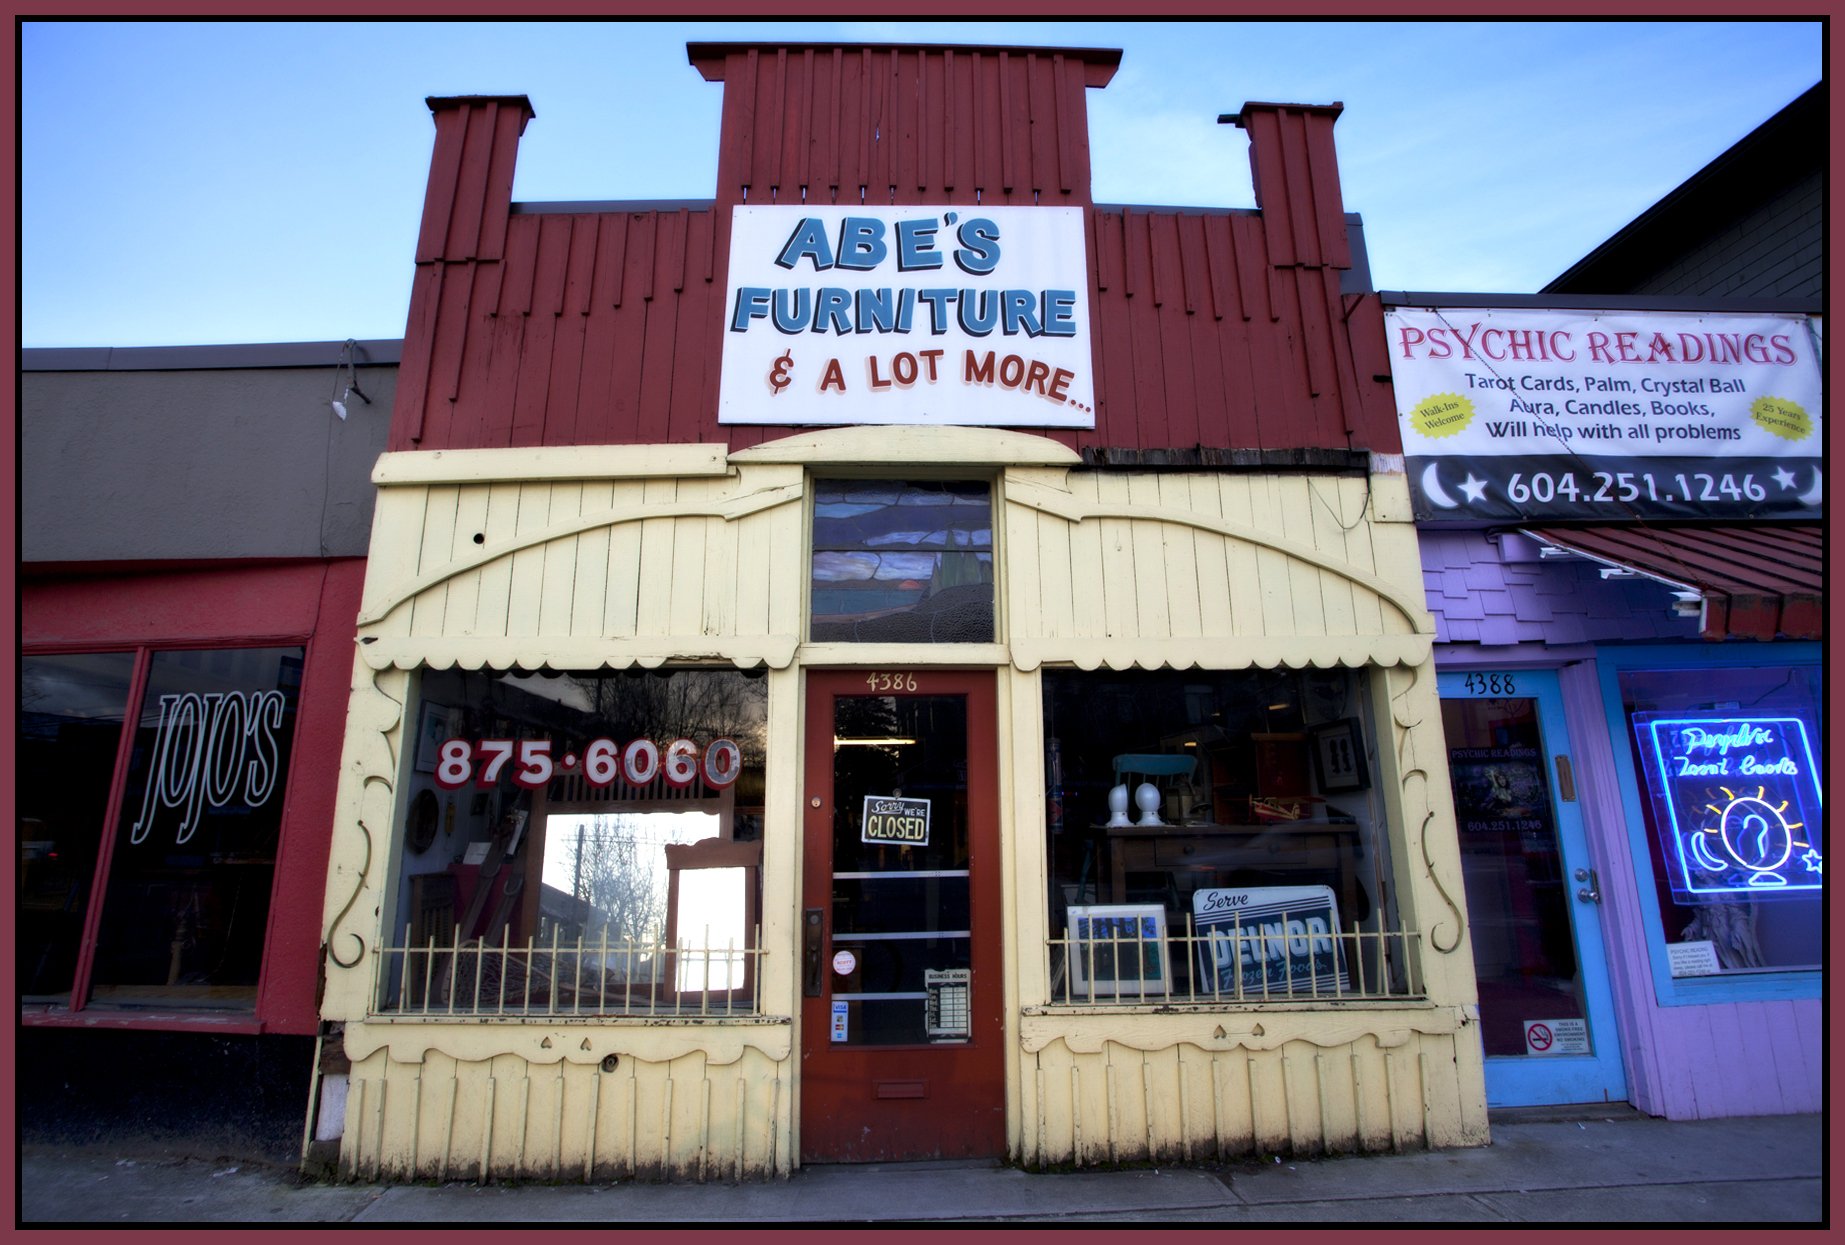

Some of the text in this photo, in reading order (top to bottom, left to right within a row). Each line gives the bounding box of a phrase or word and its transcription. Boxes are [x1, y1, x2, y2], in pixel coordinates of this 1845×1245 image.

[774, 212, 1001, 276] ABE'S
[730, 287, 1077, 338] FURNITURE
[1399, 323, 1800, 367] PSYCHIC READINGS
[817, 358, 847, 393] A
[869, 349, 944, 390] LOT
[1465, 373, 1746, 397] Tarot Cards, Palm, Crystal Ball
[1420, 402, 1459, 418] Walk-Ins
[1509, 399, 1716, 418] Aura, Candles, Books,
[1763, 403, 1801, 420] 25 Years
[1425, 413, 1465, 430] Welcome
[1486, 421, 1741, 443] Will help with all problems
[1756, 412, 1806, 434] Experience
[1506, 471, 1766, 504] 604.251.1246
[866, 672, 918, 692] 4386
[1464, 673, 1516, 695] 4388
[1451, 748, 1537, 759] PSYCHIC READINGS
[871, 800, 925, 817] Sorry WE'RE
[868, 815, 925, 840] CLOSED
[1467, 820, 1542, 832] 604.251.1246
[1203, 891, 1249, 911] Serve
